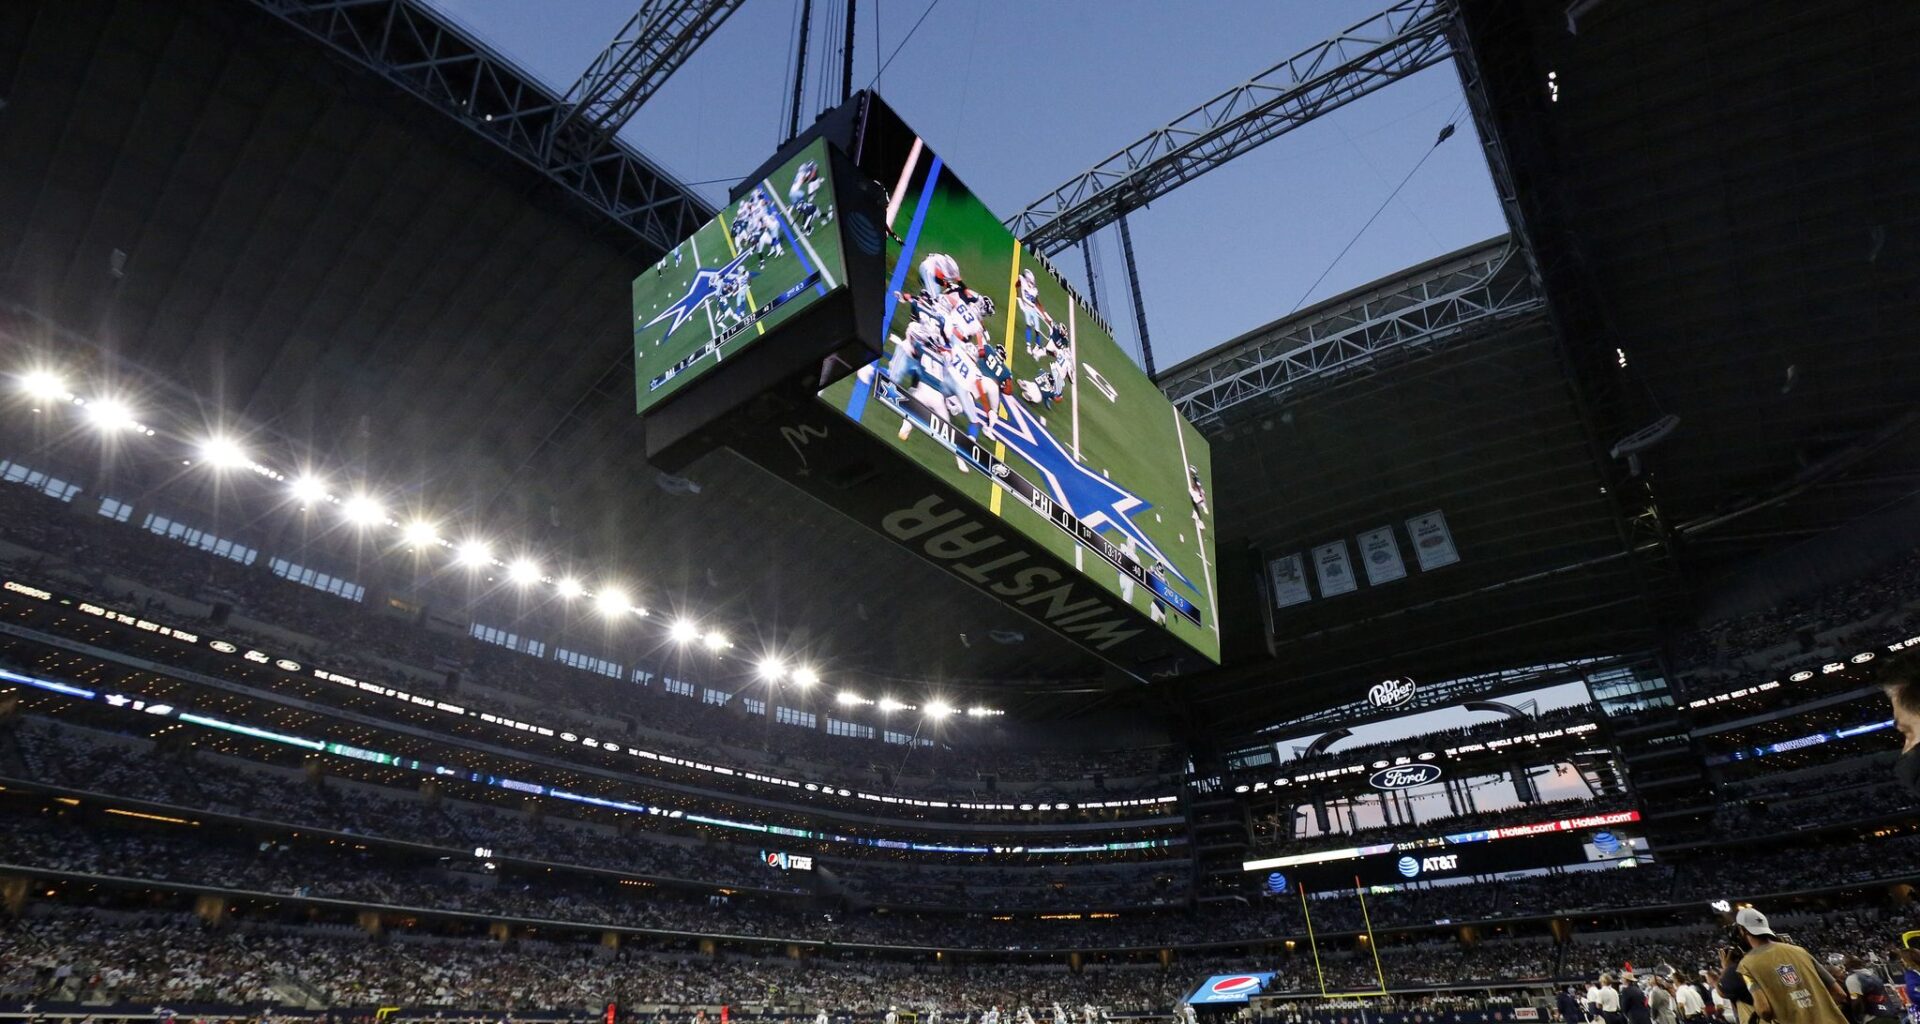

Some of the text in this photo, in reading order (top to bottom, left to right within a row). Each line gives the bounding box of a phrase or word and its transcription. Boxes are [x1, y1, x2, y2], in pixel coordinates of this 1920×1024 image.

[956, 303, 975, 324] 63
[930, 413, 980, 463] DAL 0
[1032, 488, 1052, 517] PHI
[1062, 511, 1069, 528] 0
[1103, 541, 1122, 565] 13:12
[882, 493, 1146, 651] WINSTAR
[1371, 682, 1413, 707] Pepper
[1383, 679, 1400, 694] Dr
[1384, 767, 1427, 787] Ford
[1501, 823, 1555, 837] Hotels.com
[1572, 813, 1631, 828] Hotels.com
[1397, 841, 1415, 851] 13:11
[1423, 855, 1457, 872] AT&T
